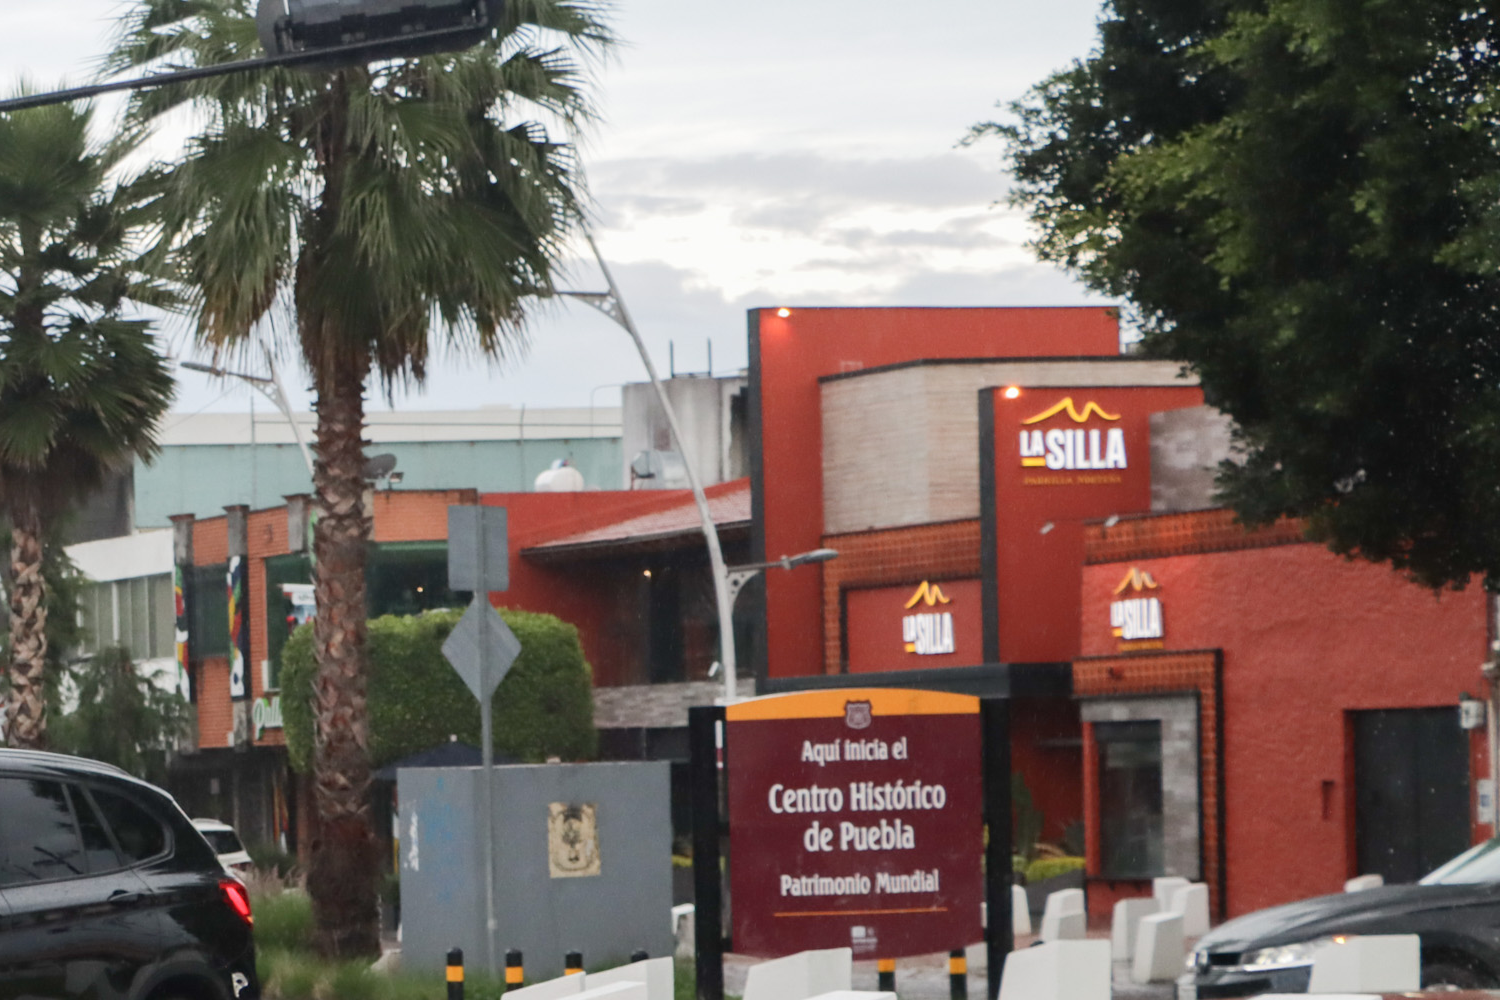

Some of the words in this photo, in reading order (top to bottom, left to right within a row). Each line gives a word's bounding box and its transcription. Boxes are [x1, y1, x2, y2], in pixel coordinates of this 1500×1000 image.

[1019, 430, 1045, 457] LA
[1045, 428, 1127, 470] SILLA
[915, 613, 954, 655] SILLA
[1122, 598, 1163, 639] SILLA
[801, 739, 841, 767] Aquí
[844, 739, 889, 761] inicia
[891, 736, 908, 760] el
[768, 783, 844, 814] Centro
[849, 779, 946, 812] Histórico
[803, 820, 834, 852] de
[839, 818, 916, 851] Puebla
[780, 873, 871, 896] Patrimonio
[875, 868, 940, 894] Mundial
